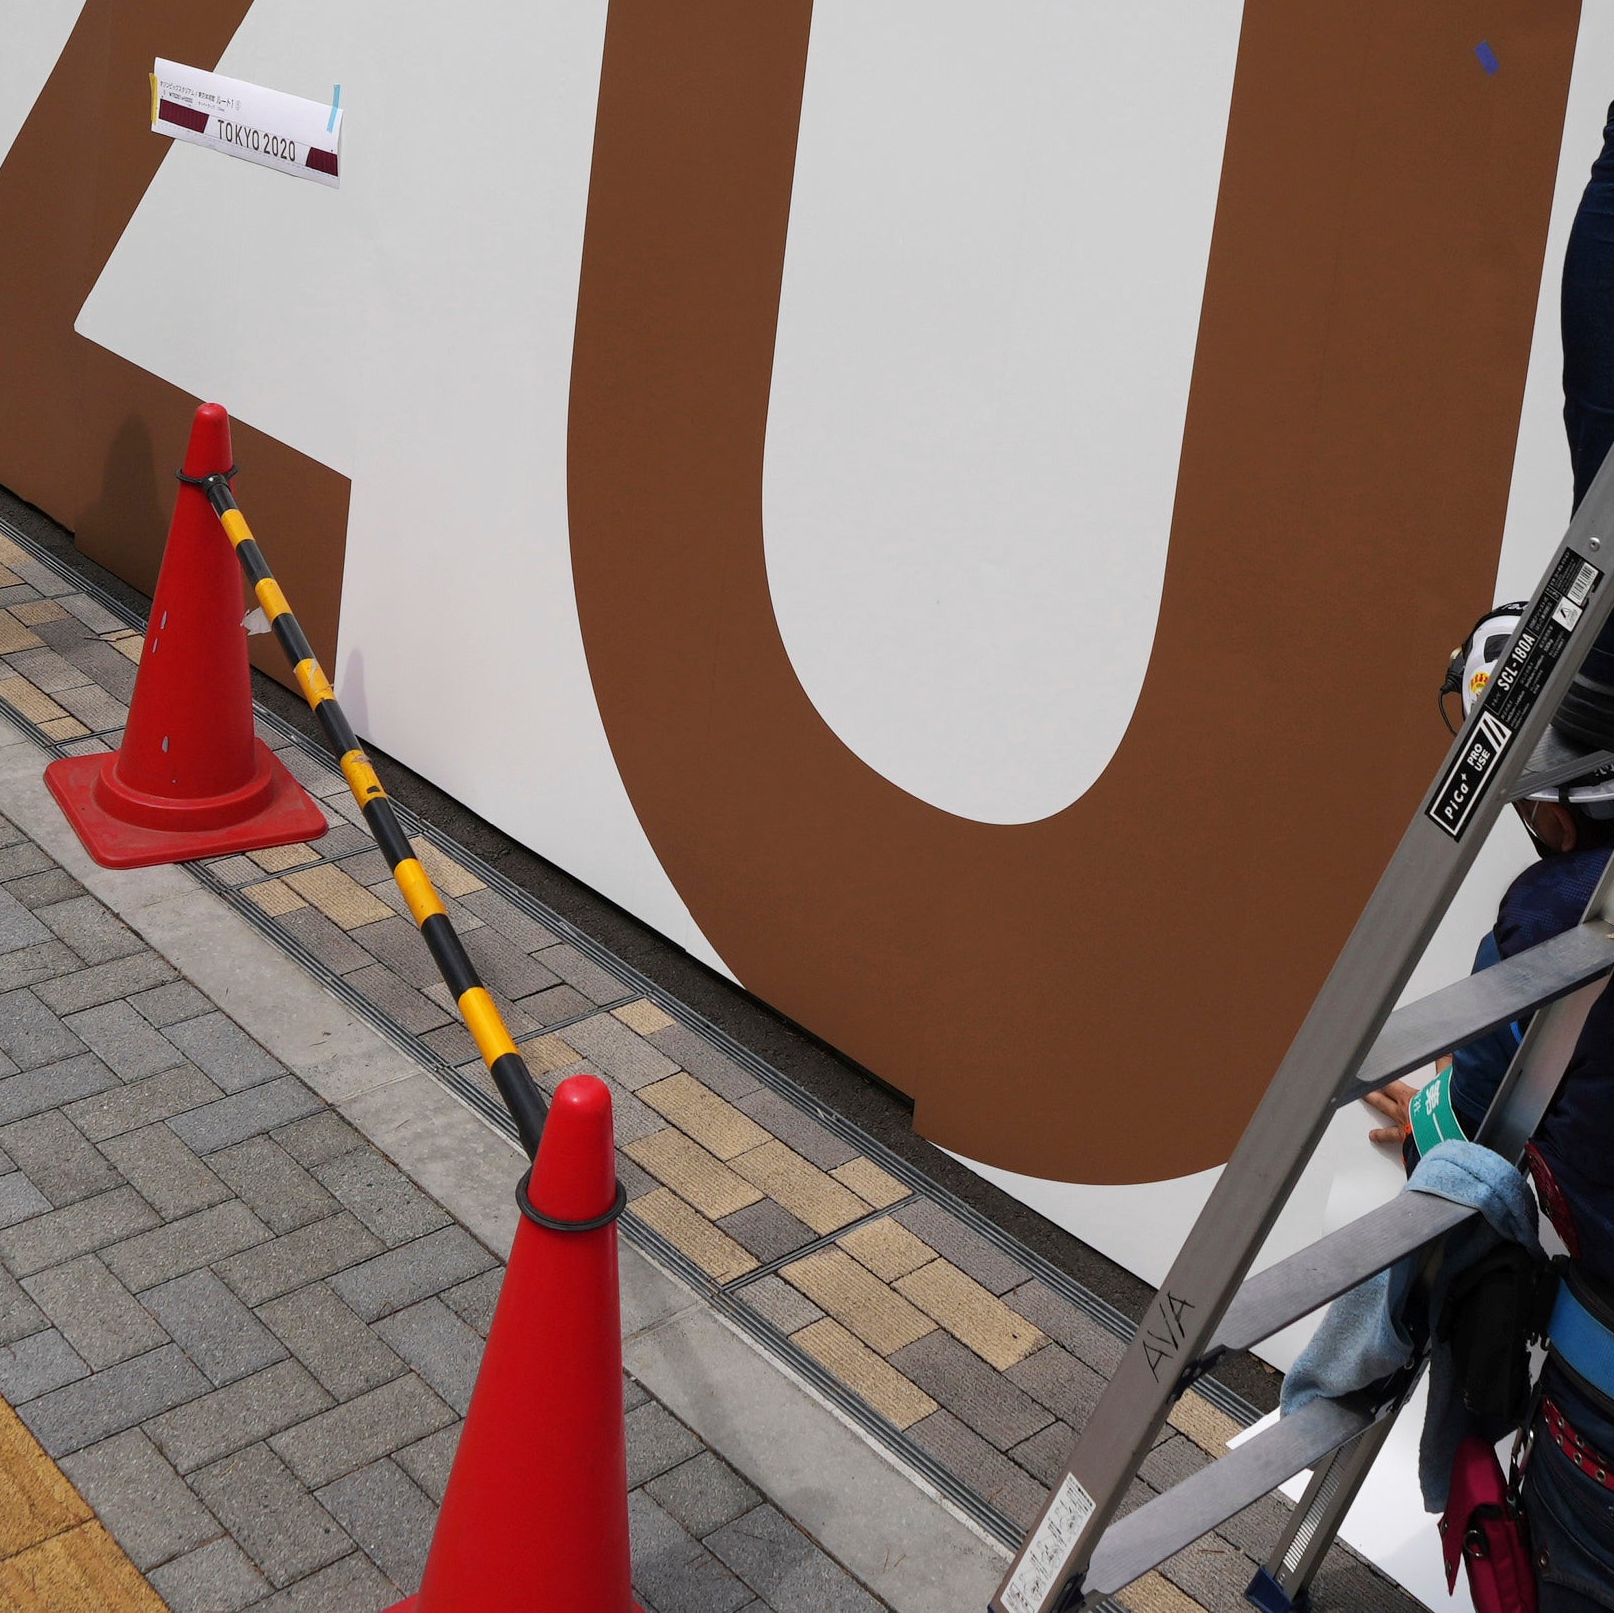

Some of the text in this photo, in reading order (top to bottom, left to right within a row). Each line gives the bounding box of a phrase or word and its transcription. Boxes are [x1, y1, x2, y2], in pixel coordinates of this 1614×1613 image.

[218, 120, 296, 162] TOKYO 2020
[1496, 633, 1536, 692] SCL-180A
[1467, 743, 1483, 767] PRO
[1475, 750, 1491, 773] USE
[1445, 783, 1469, 819] PiCa
